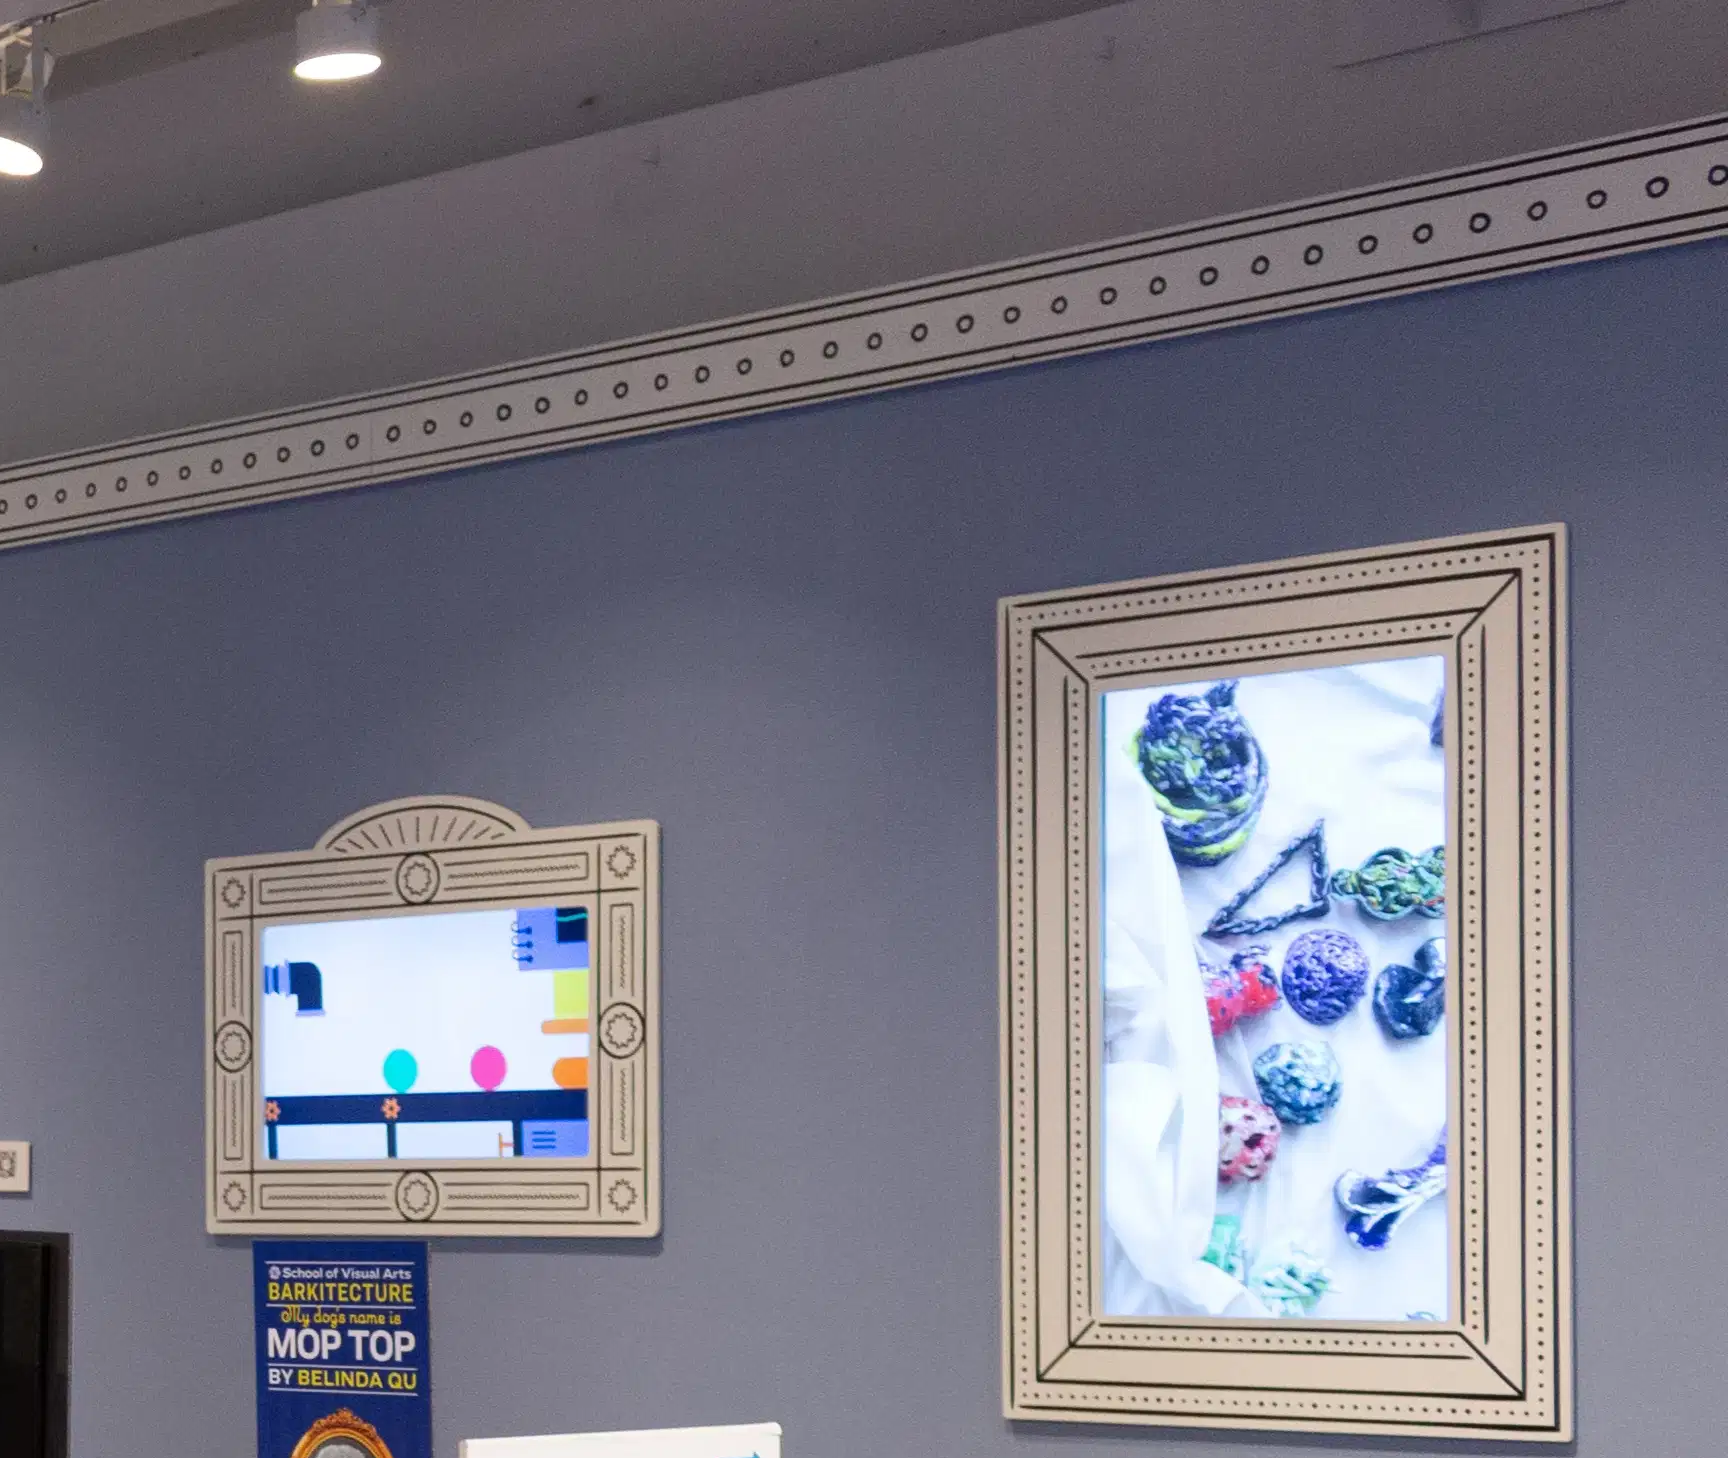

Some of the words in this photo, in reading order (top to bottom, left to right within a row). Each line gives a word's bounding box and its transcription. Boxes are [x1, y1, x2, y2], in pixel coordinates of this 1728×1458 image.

[282, 1266, 323, 1279] School
[325, 1267, 339, 1279] of
[341, 1268, 380, 1280] Visual
[382, 1269, 412, 1280] Arts
[268, 1281, 414, 1303] BARKITECTURE
[280, 1305, 310, 1328] My
[349, 1312, 386, 1325] name
[389, 1311, 402, 1326] is
[267, 1327, 342, 1360] MOP
[348, 1329, 417, 1362] TOP
[268, 1368, 294, 1385] BY
[297, 1369, 384, 1389] BELINDA
[388, 1372, 417, 1390] QU
